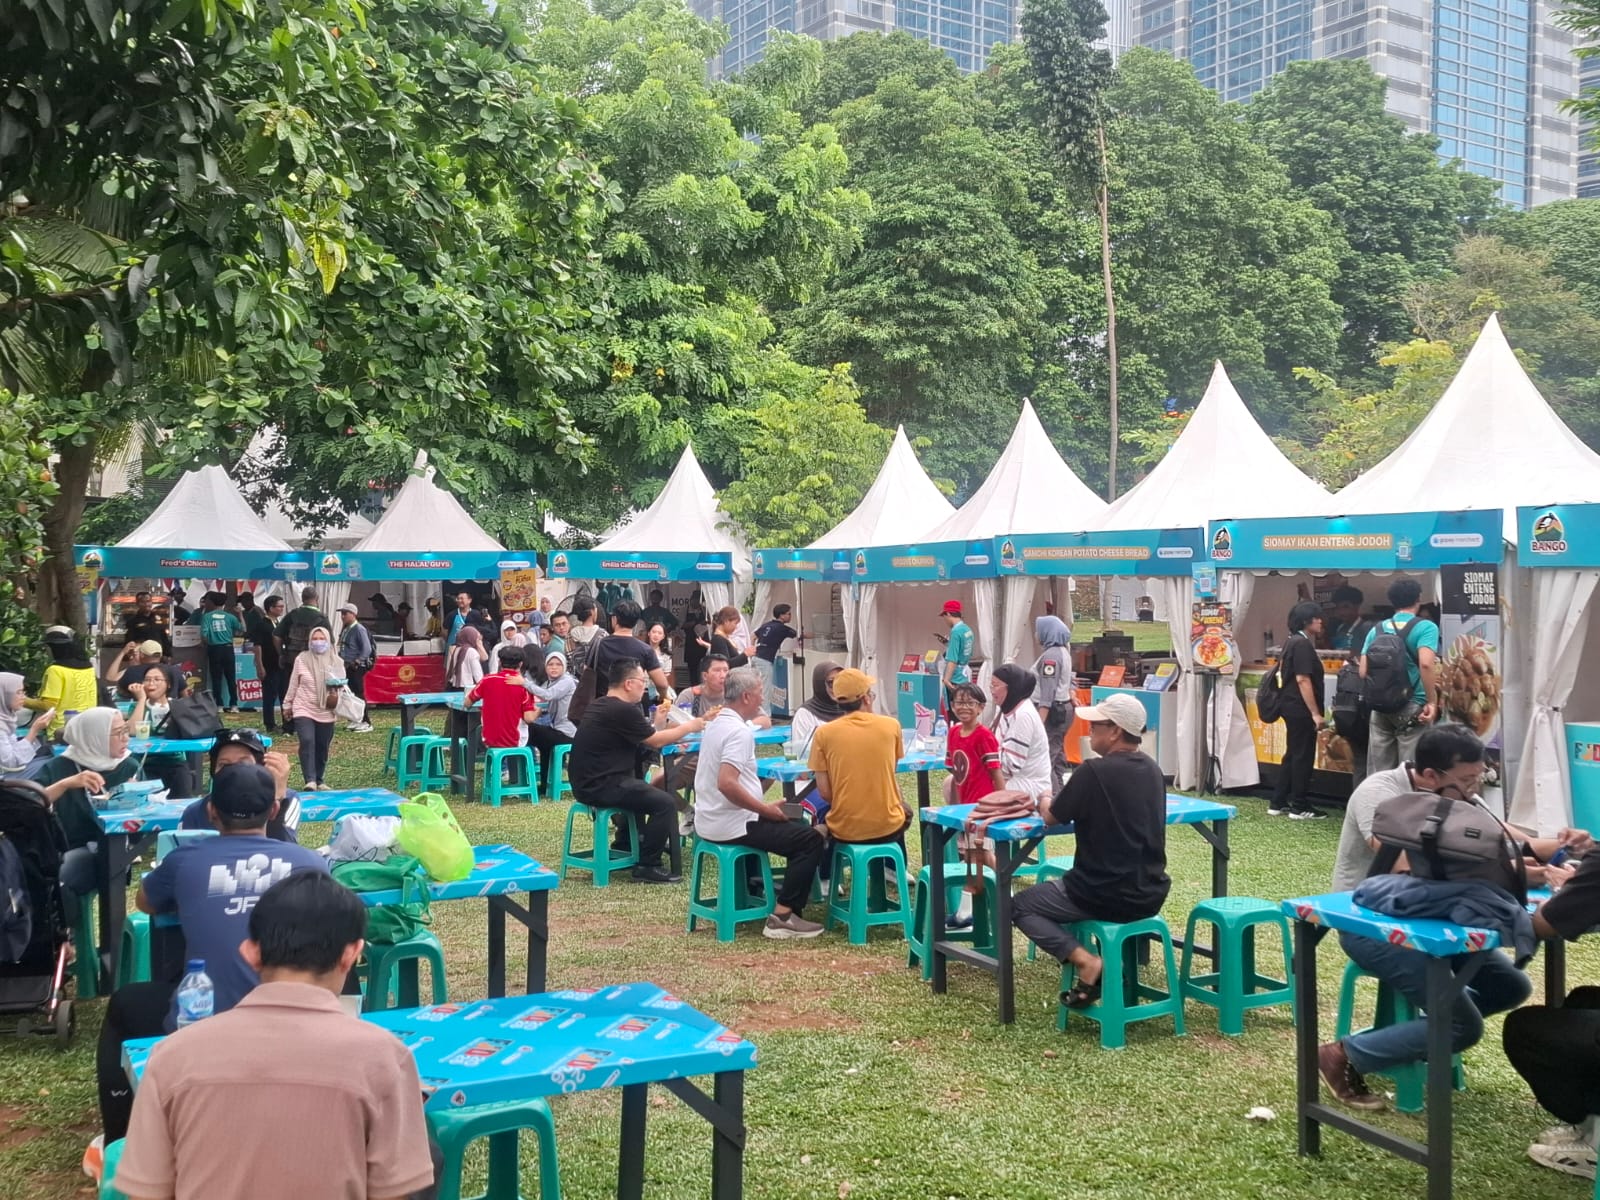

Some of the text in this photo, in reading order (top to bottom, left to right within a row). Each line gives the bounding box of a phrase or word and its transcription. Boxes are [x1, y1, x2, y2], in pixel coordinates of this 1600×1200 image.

[1264, 536, 1390, 547] SIOMAY IKAN ENTENG JODOH
[1531, 541, 1566, 551] BANGO
[1073, 549, 1098, 557] POTATO
[1099, 548, 1124, 557] CHEESE
[1464, 572, 1494, 582] SIOMAY
[1463, 583, 1494, 593] ENTENG
[1467, 594, 1495, 604] JODOH
[240, 688, 262, 700] fusi
[224, 896, 260, 915] JF
